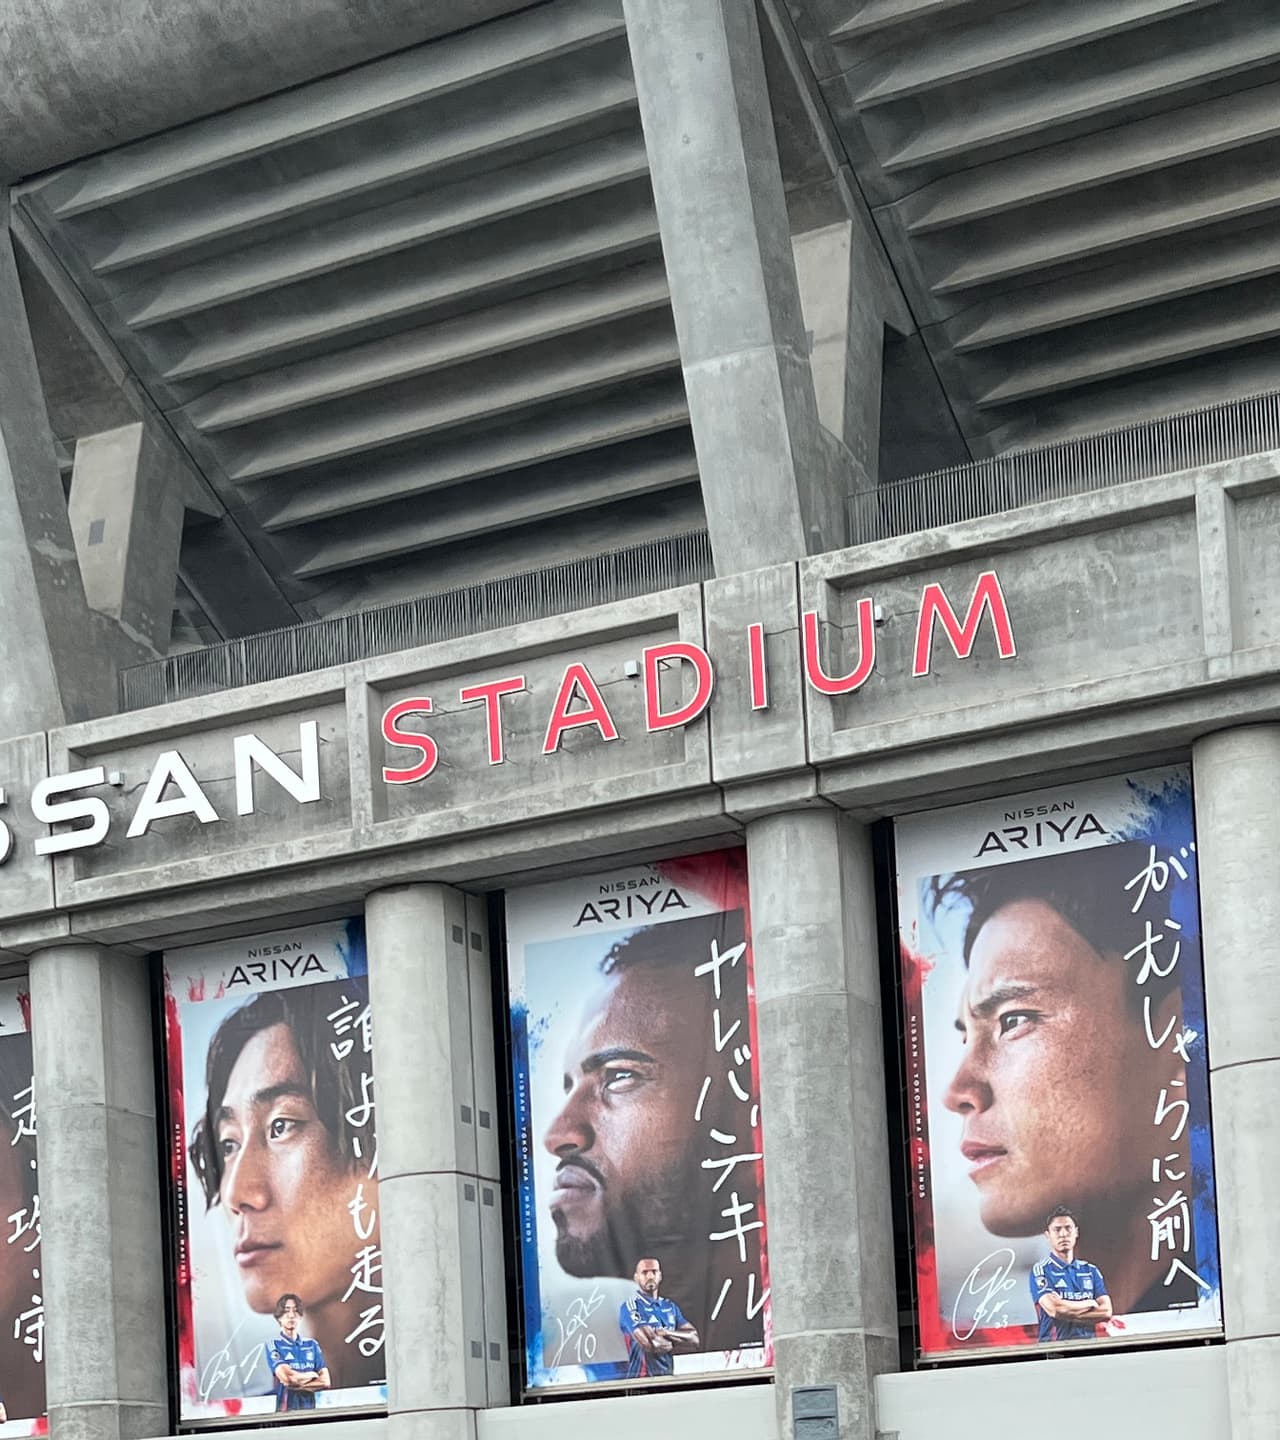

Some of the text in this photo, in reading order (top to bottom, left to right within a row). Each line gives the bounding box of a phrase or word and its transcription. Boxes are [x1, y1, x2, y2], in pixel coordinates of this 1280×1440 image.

[382, 569, 1017, 786] STADIUM
[1004, 800, 1076, 822] NISSAN
[973, 813, 1111, 858] ARIYA
[598, 875, 662, 895] NISSAN
[572, 888, 691, 928] ARIYA
[247, 942, 303, 958] NISSAN
[224, 954, 329, 989] ARIYA
[1122, 843, 1211, 1290] がむしゃらに前へ
